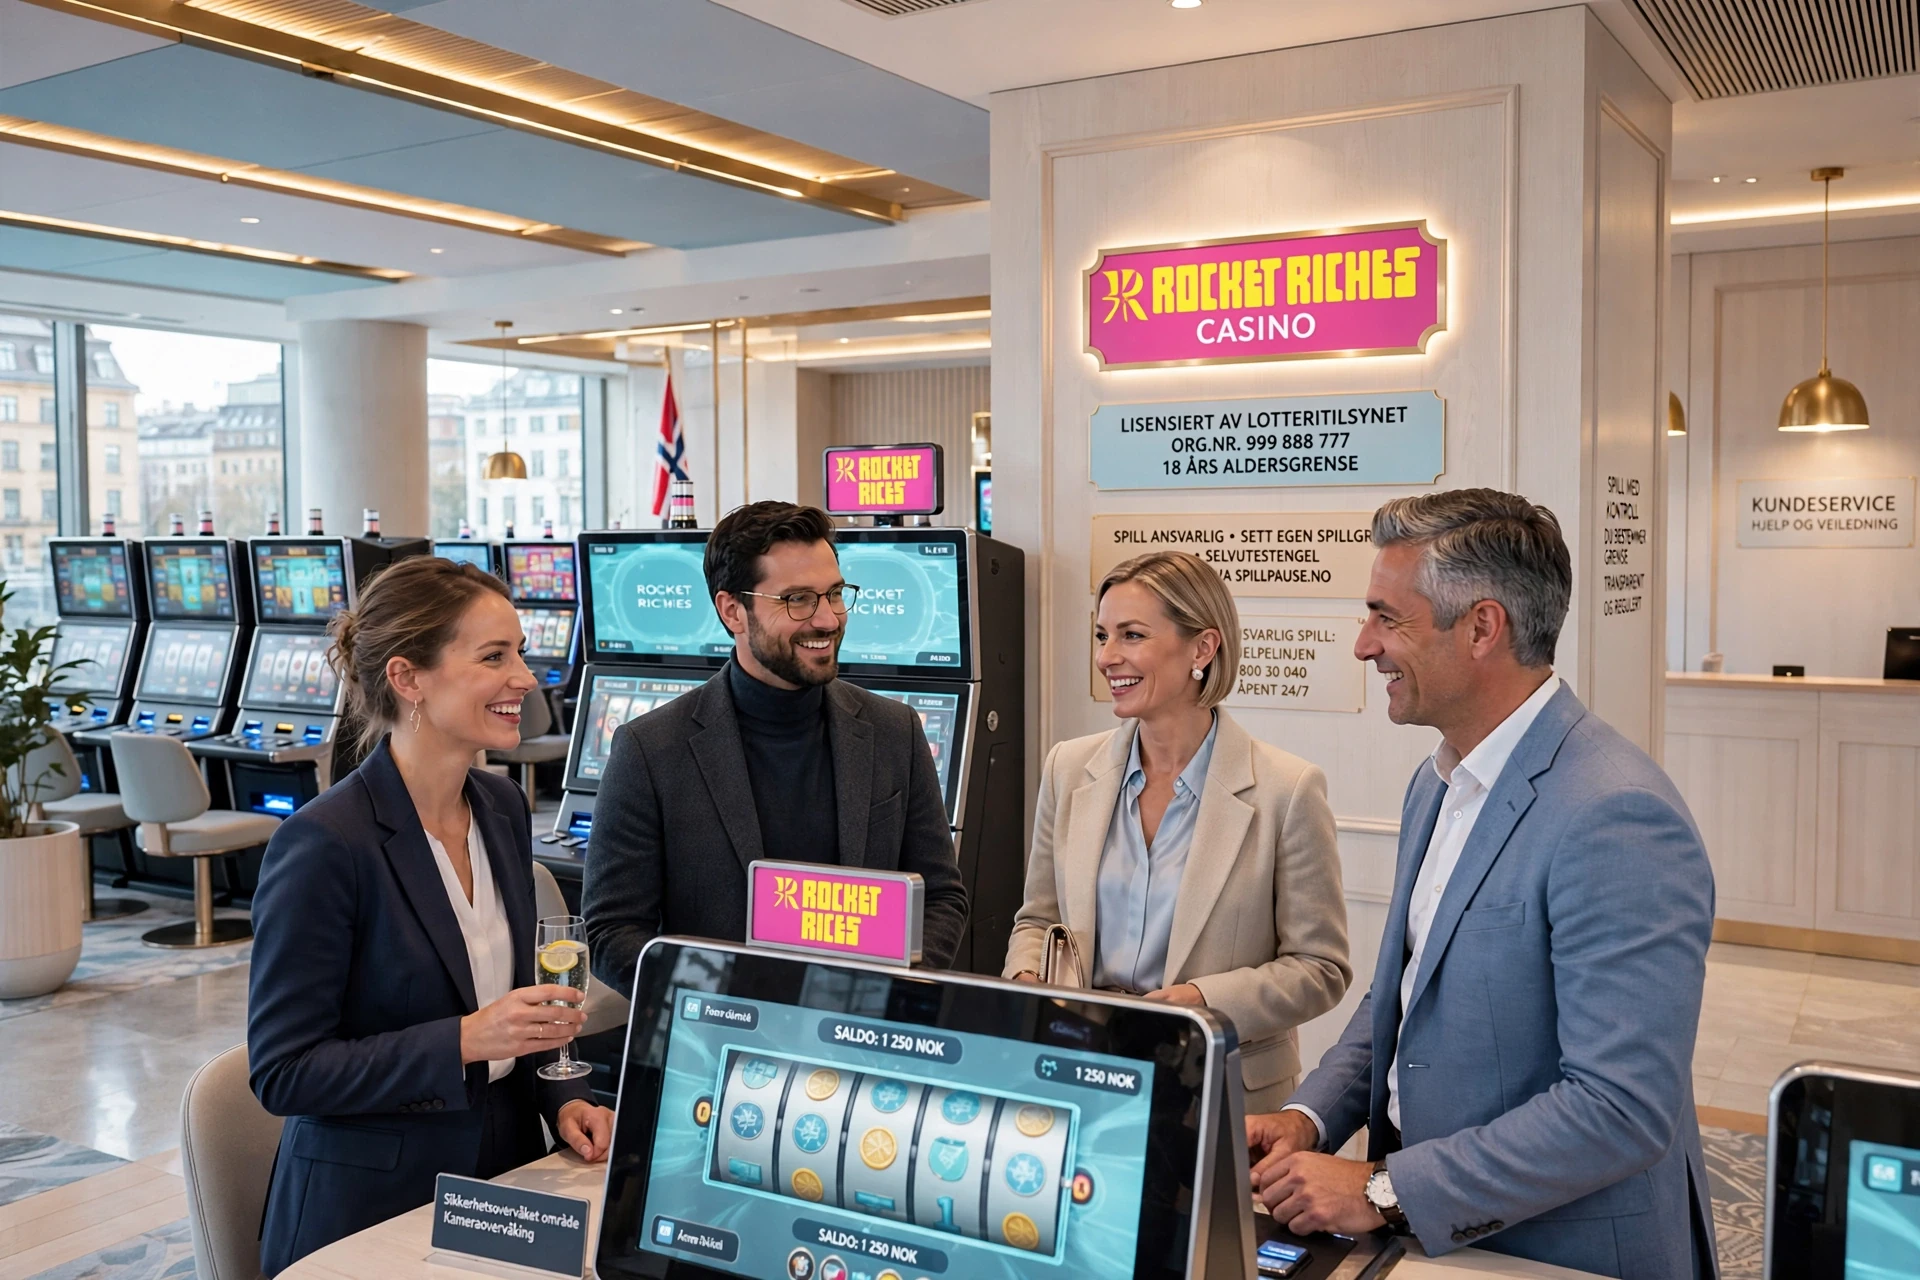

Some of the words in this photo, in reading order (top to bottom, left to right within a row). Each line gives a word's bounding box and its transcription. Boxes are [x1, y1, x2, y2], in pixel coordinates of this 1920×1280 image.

[1152, 258, 1282, 315] ROCKET
[1286, 246, 1421, 305] RICHES
[1196, 312, 1316, 344] CASINO
[1121, 414, 1214, 433] LISENSIERT
[1219, 413, 1242, 429] AV
[1248, 406, 1408, 428] LOTTERITILSYNET
[1171, 437, 1241, 453] ORG.NR.
[1246, 435, 1277, 450] 999
[1282, 433, 1313, 449] 888
[1319, 432, 1350, 449] 777
[858, 455, 921, 481] ROCKET
[1163, 460, 1181, 475] 18
[1186, 456, 1218, 474] ÅRS
[1223, 455, 1358, 474] ALDERSGRENSE
[858, 481, 906, 505] RICES
[1752, 495, 1896, 513] KUNDESERVICE
[1752, 519, 1790, 531] HJELP
[1793, 518, 1813, 531] OG
[1817, 518, 1898, 531] VEILEDNING
[1114, 530, 1147, 543] SPILL
[1151, 530, 1224, 543] ANSVARLIG
[1240, 530, 1273, 543] SETT
[1277, 530, 1313, 543] EGEN
[1205, 549, 1320, 563] SELVUTESTENGEL
[1235, 569, 1331, 582] SPILLPAUSE.NO
[636, 584, 692, 596] ROCKET
[856, 588, 905, 600] OCKET
[1297, 630, 1336, 642] SPILL:
[1239, 665, 1262, 677] 800
[1265, 666, 1280, 677] 30
[1283, 666, 1307, 678] 040
[1237, 679, 1278, 695] ÅPENT
[1281, 684, 1309, 697] 24/7
[802, 879, 882, 916] ROCKET
[801, 911, 862, 946] RICES
[834, 1025, 879, 1046] SALDO:
[891, 1034, 914, 1051] 250
[916, 1037, 945, 1057] NOK
[1084, 1068, 1106, 1084] 250
[1107, 1072, 1135, 1089] NOK
[443, 1210, 535, 1243] Kameraovervåking
[541, 1211, 580, 1230] område
[818, 1228, 859, 1249] SALDO:
[869, 1241, 889, 1257] 250
[890, 1246, 918, 1264] NOK
